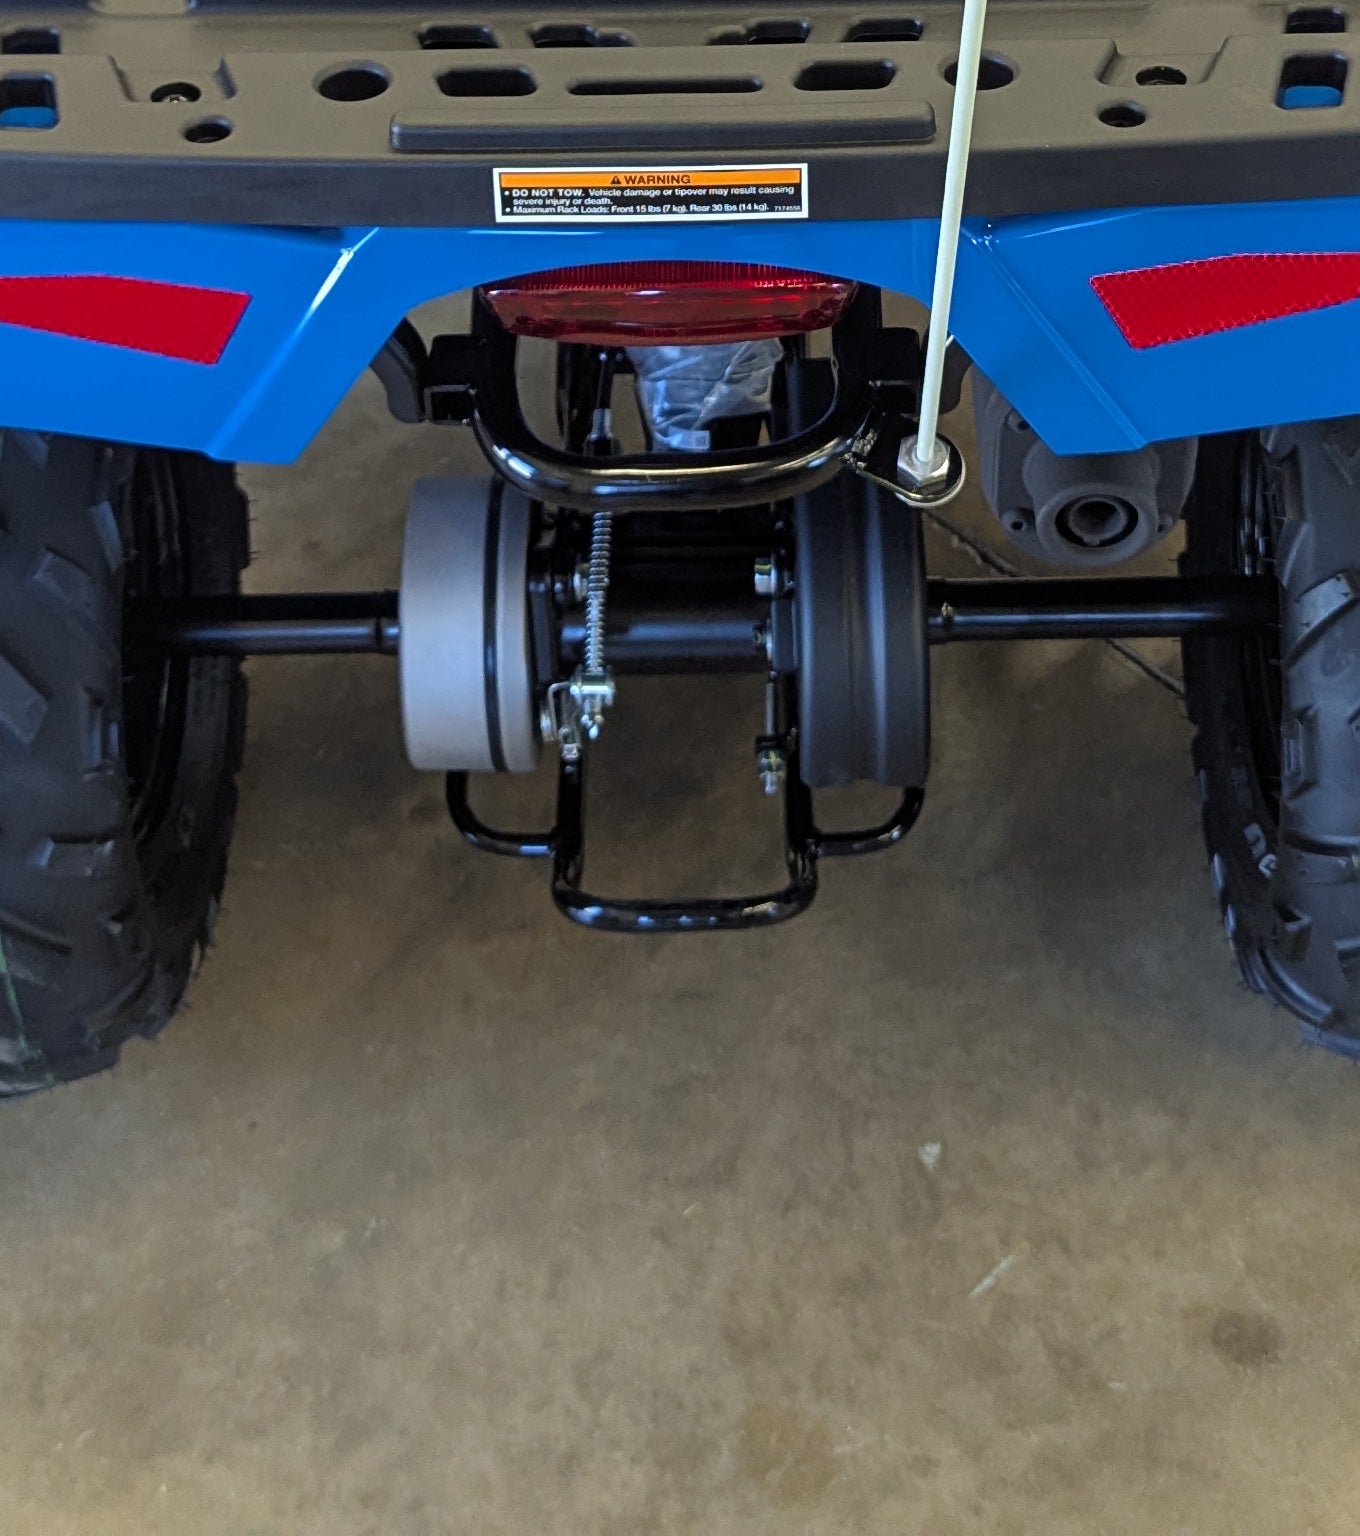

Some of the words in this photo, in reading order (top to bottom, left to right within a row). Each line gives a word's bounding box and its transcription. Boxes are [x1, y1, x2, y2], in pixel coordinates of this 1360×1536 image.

[624, 174, 691, 185] WARNING
[512, 188, 529, 197] DO
[531, 188, 554, 197] NOT
[557, 188, 585, 197] TOW.
[588, 188, 622, 197] Vehicle
[623, 188, 661, 198] damage
[662, 188, 673, 196] or
[674, 187, 707, 197] tipover
[708, 187, 729, 197] may
[730, 186, 757, 195] result
[758, 185, 795, 195] causing
[513, 198, 544, 206] severe
[545, 197, 571, 207] injury
[584, 197, 614, 205] death.
[512, 205, 556, 214] Maximum
[557, 205, 579, 213] Rack
[580, 205, 610, 214] Loads:
[611, 205, 635, 213] Front
[635, 204, 647, 213] 15
[647, 204, 661, 213] lbs
[662, 204, 671, 214] (7
[672, 204, 688, 214] kg).
[689, 204, 710, 212] Rear
[711, 203, 723, 212] 30
[724, 203, 738, 212] lbs
[738, 202, 752, 213] (14
[753, 202, 770, 212] kg).
